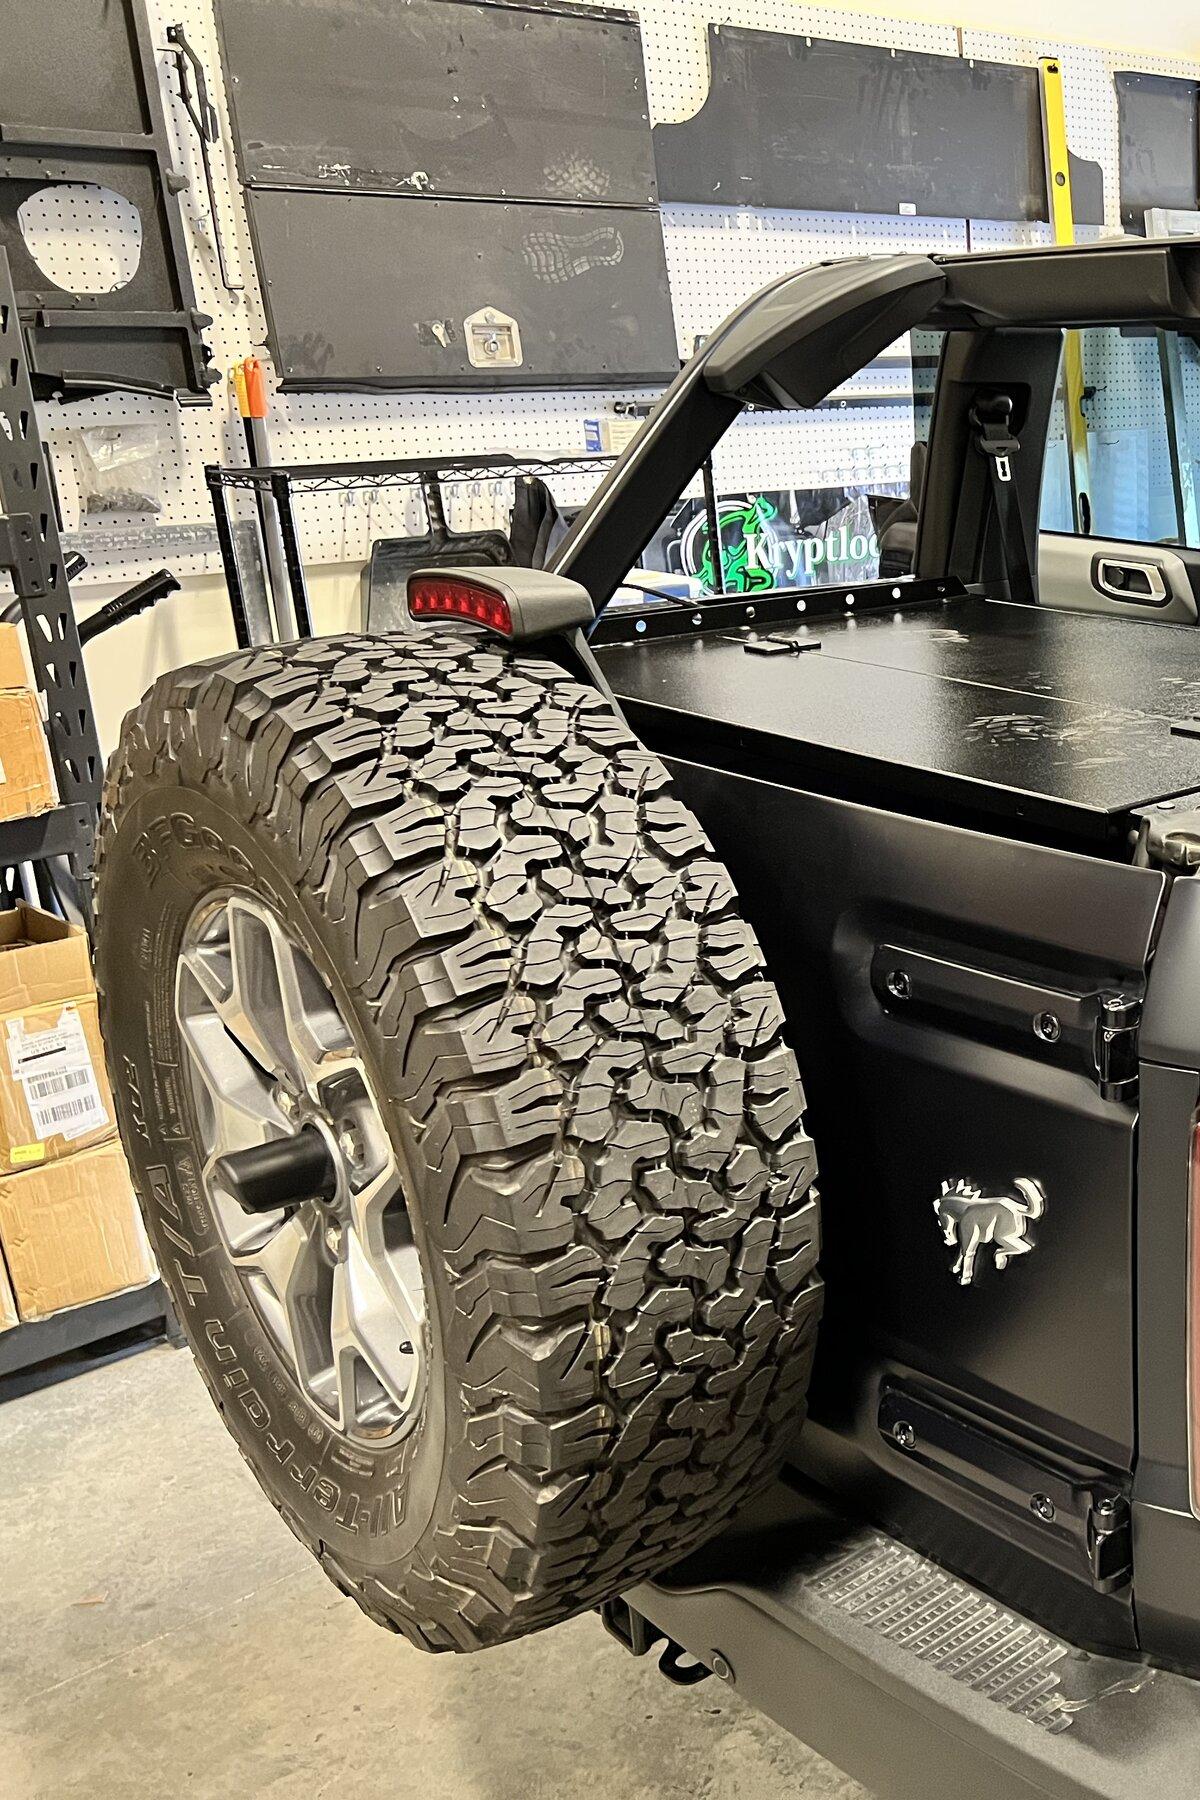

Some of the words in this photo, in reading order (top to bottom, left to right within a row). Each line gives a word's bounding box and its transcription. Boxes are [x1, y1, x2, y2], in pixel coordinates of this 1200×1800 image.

[132, 811, 314, 955] BFGood
[146, 1163, 209, 1308] T/A
[204, 1318, 411, 1539] All-Terrain
